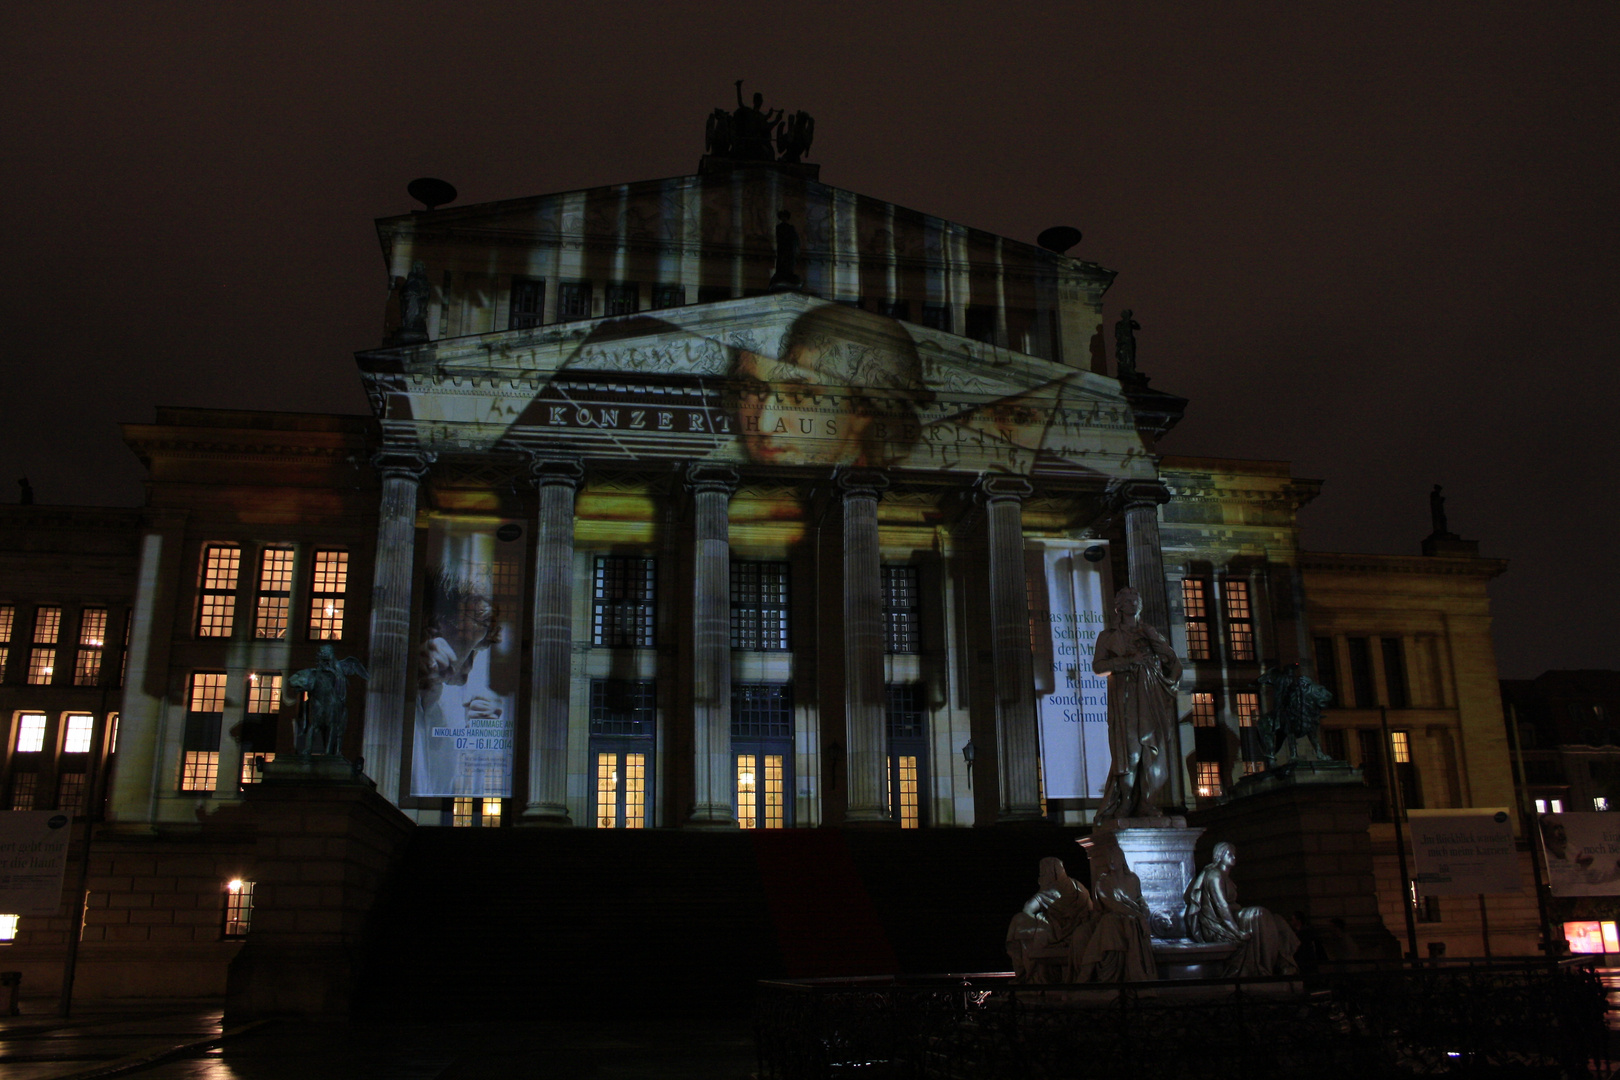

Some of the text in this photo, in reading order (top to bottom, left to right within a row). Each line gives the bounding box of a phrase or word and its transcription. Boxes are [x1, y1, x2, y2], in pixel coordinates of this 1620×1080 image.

[549, 406, 837, 436] KONZERTHAUS
[874, 419, 1014, 445] BERLIN
[1064, 609, 1112, 624] wirklich
[1054, 625, 1096, 640] Schöne
[1058, 642, 1078, 656] der
[1049, 658, 1092, 673] ist nich
[1066, 675, 1107, 689] Reinhe
[1049, 691, 1108, 706] sondern d
[1063, 708, 1108, 723] Schmut
[471, 719, 503, 728] HOMMAGE
[434, 728, 513, 738] NIKOLAUS HARNONCOURT
